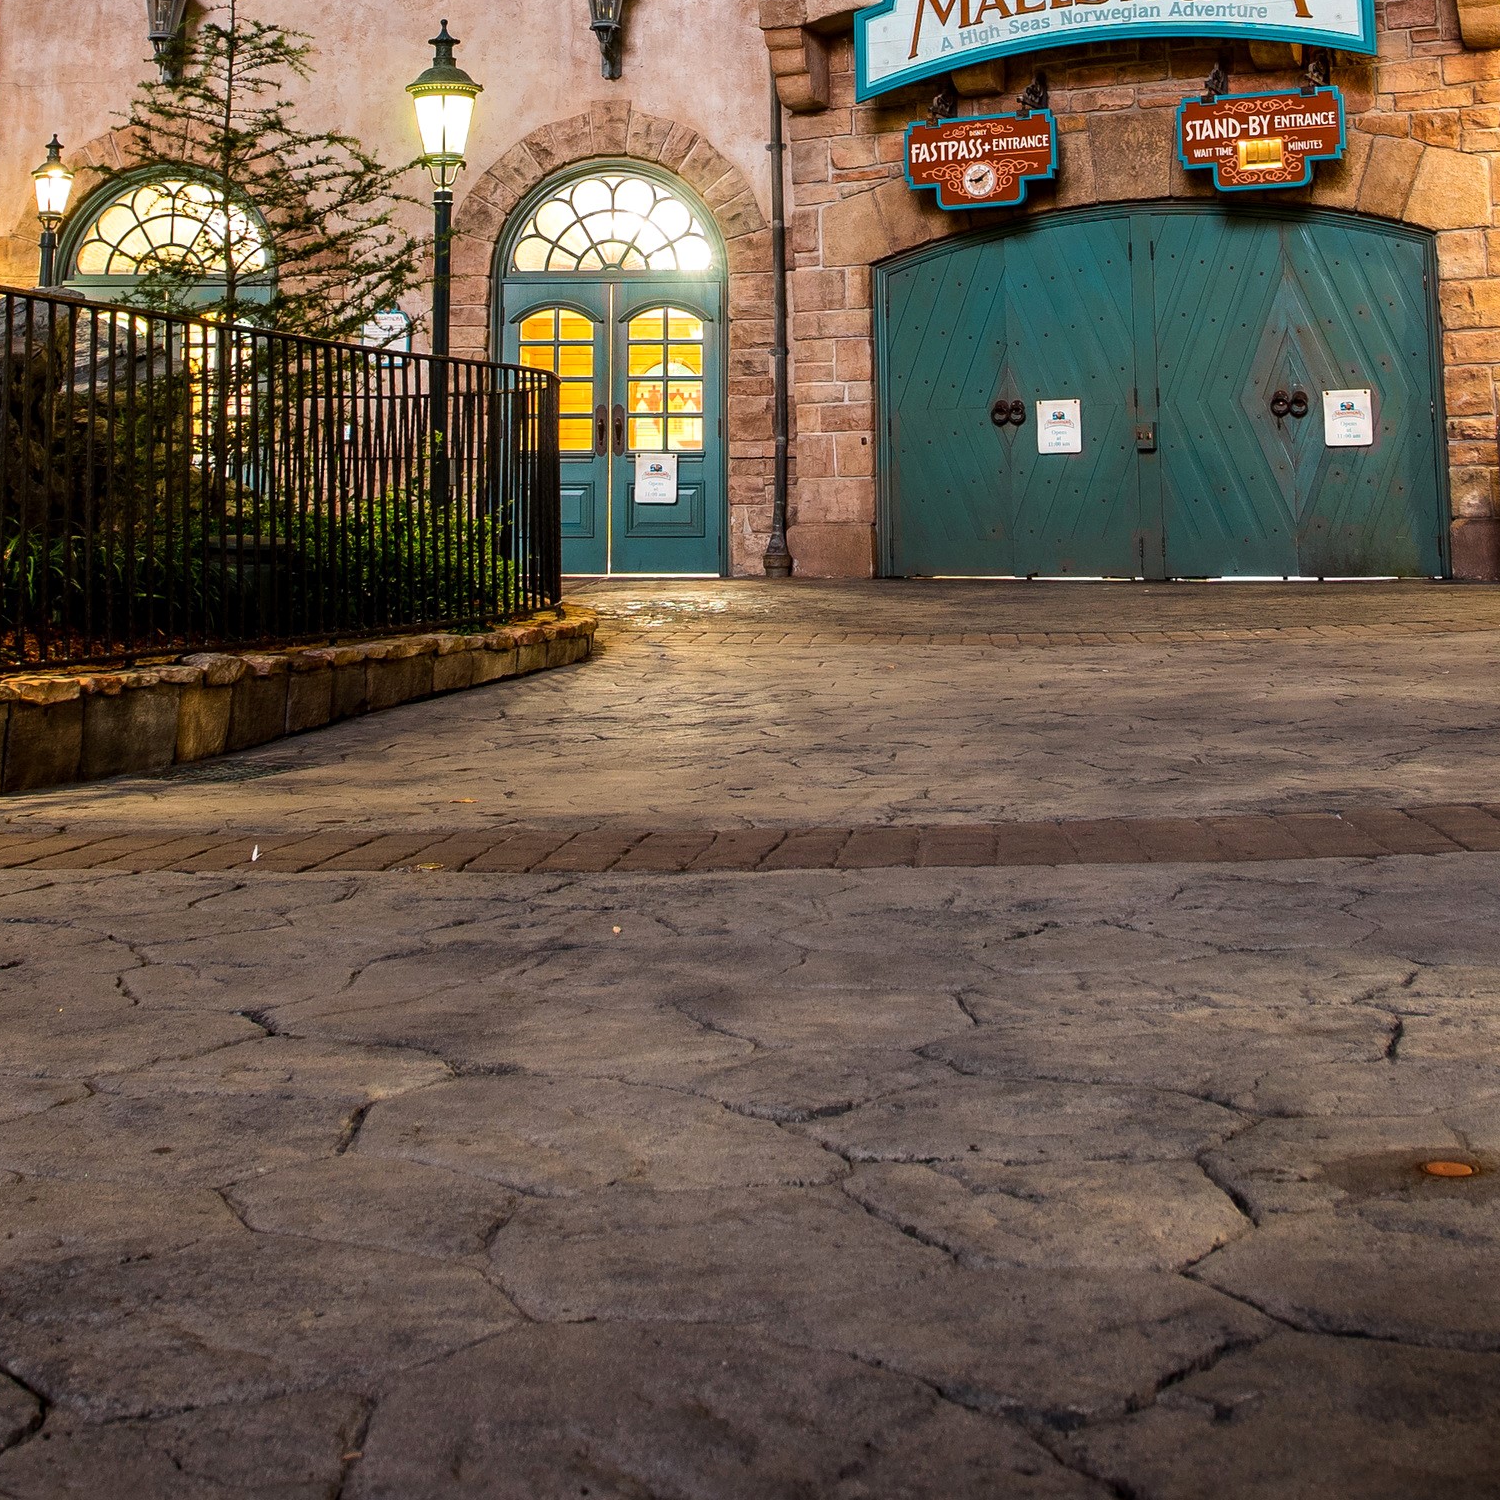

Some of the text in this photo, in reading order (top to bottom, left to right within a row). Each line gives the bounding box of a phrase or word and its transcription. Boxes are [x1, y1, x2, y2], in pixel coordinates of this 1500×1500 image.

[940, 1, 1268, 52] A High Seas Norwegian Adventure
[969, 129, 988, 137] DISNEY
[1185, 111, 1336, 142] STAND-BY ENTRANCE
[911, 134, 1049, 164] FASTPASS+ ENTRANCE
[1193, 139, 1323, 158] WAIT TIME MINUTES
